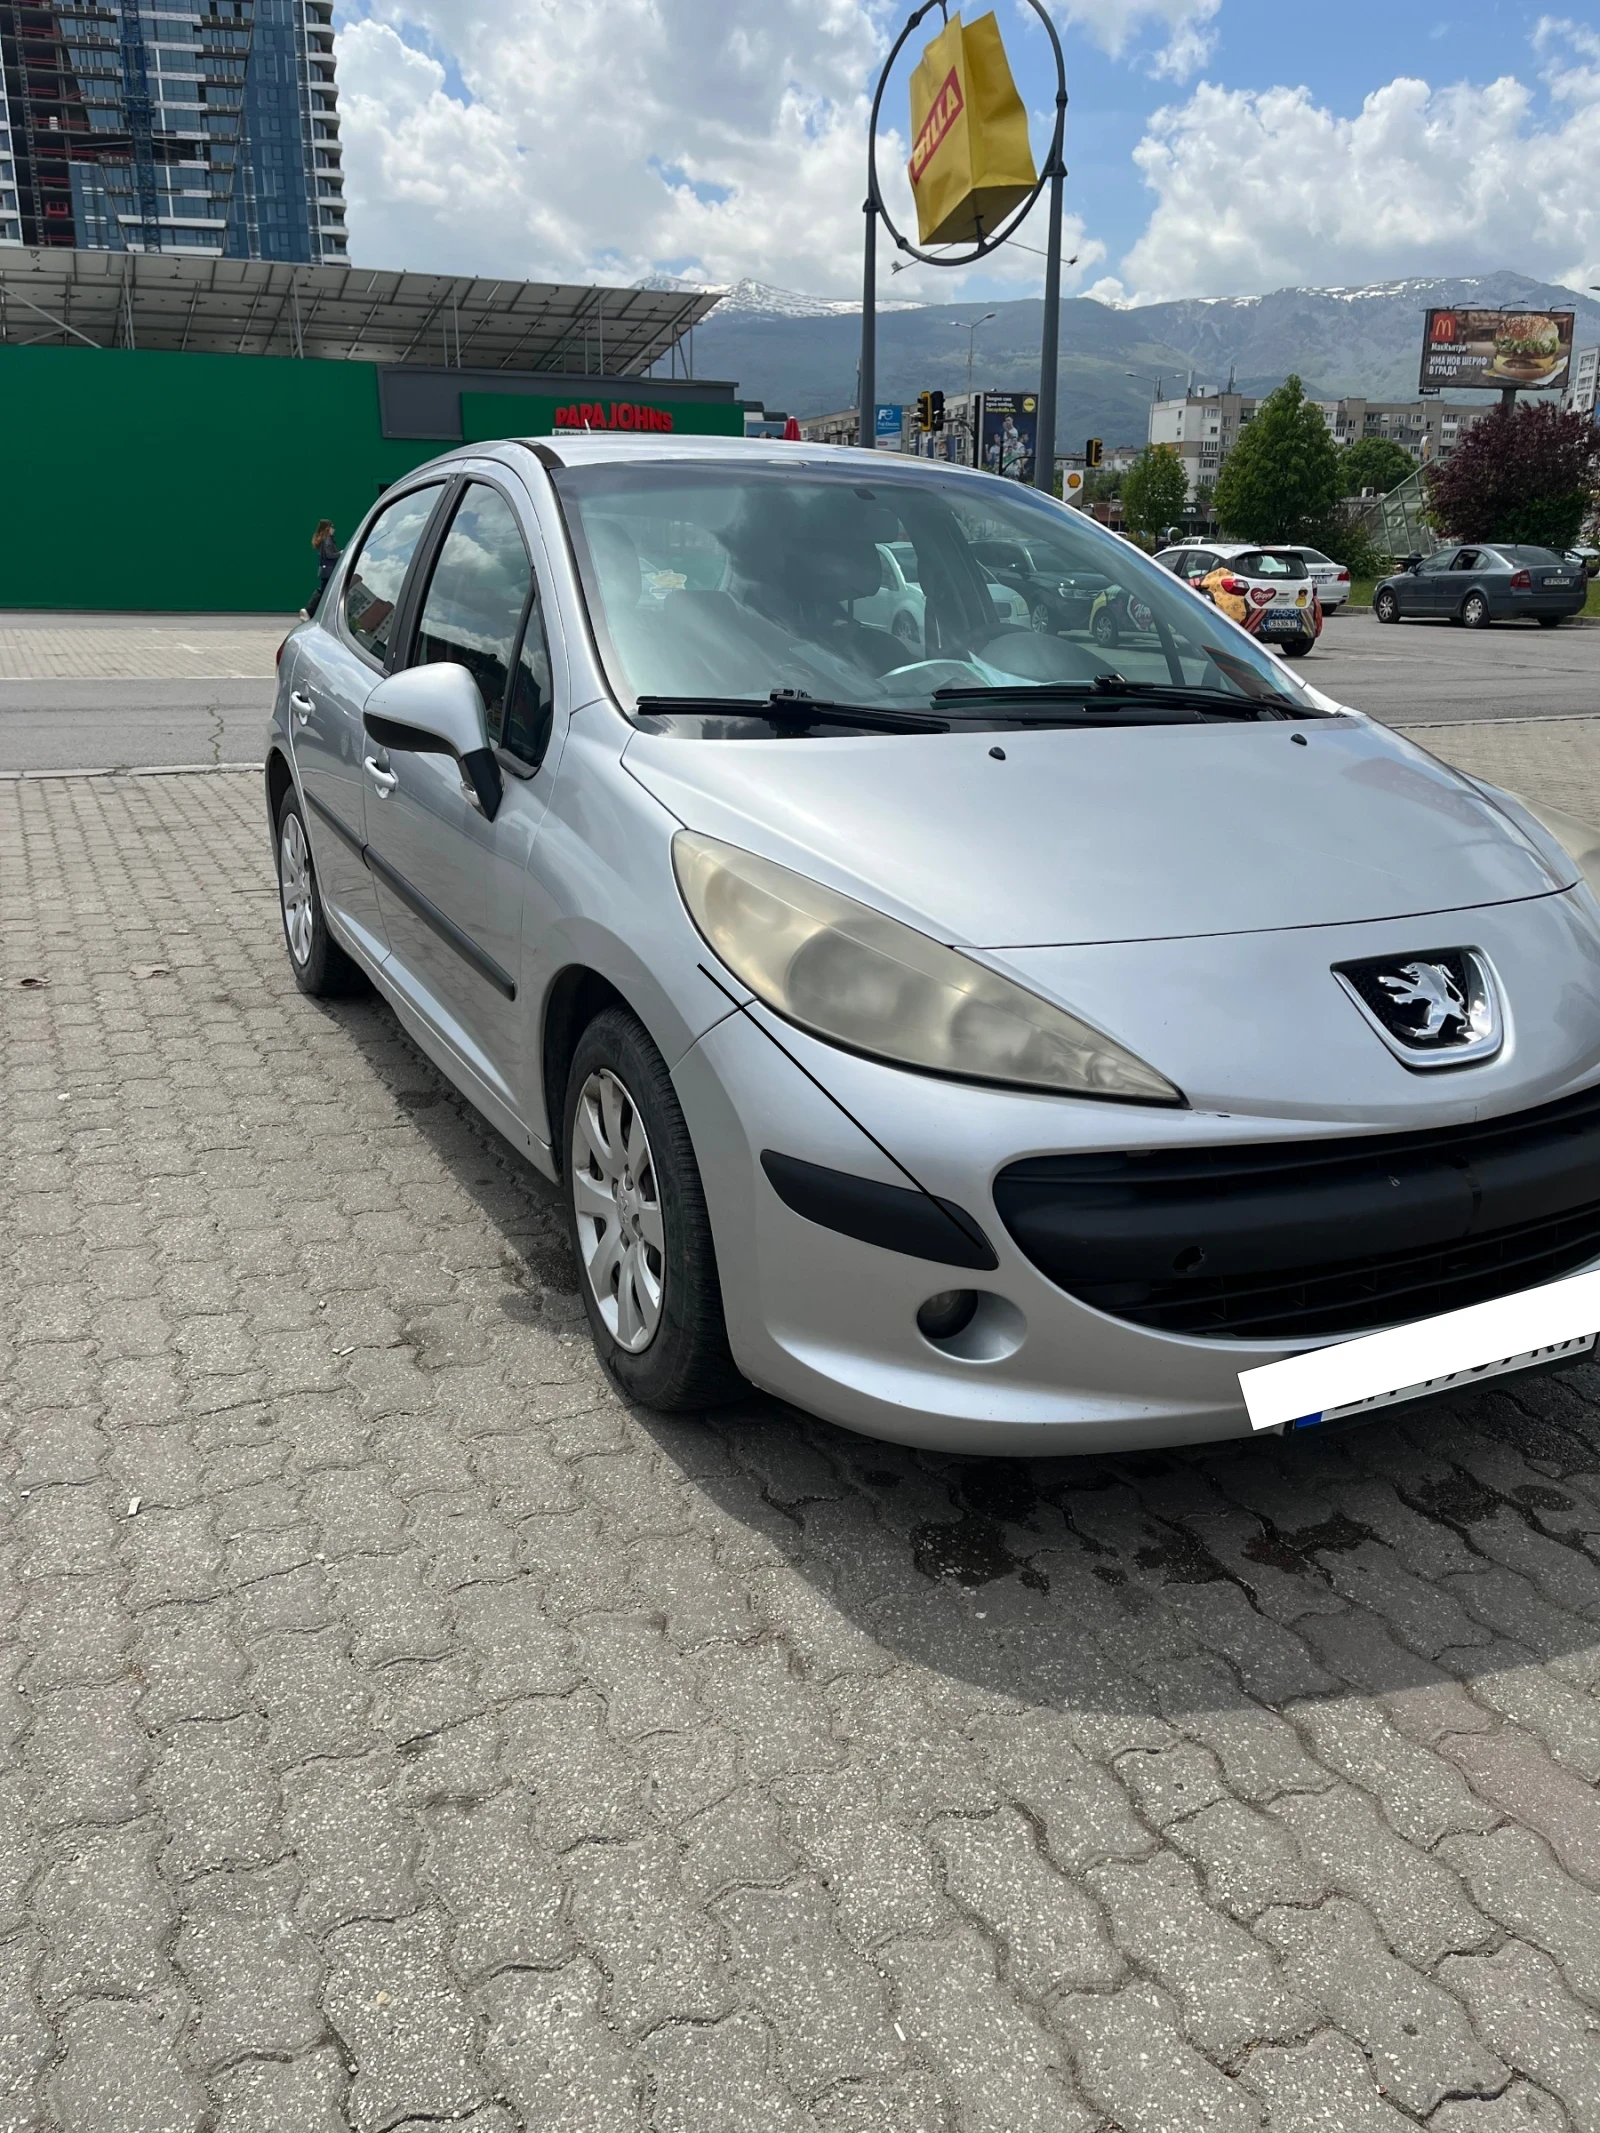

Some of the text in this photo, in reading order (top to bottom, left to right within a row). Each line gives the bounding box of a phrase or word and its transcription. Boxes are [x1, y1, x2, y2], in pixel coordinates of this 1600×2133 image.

[912, 83, 961, 174] BILLA
[1430, 355, 1488, 366] ИМА НОВ ШЕРИФ
[1434, 365, 1458, 376] ГРАДА
[555, 402, 674, 432] PAPA JOHNS
